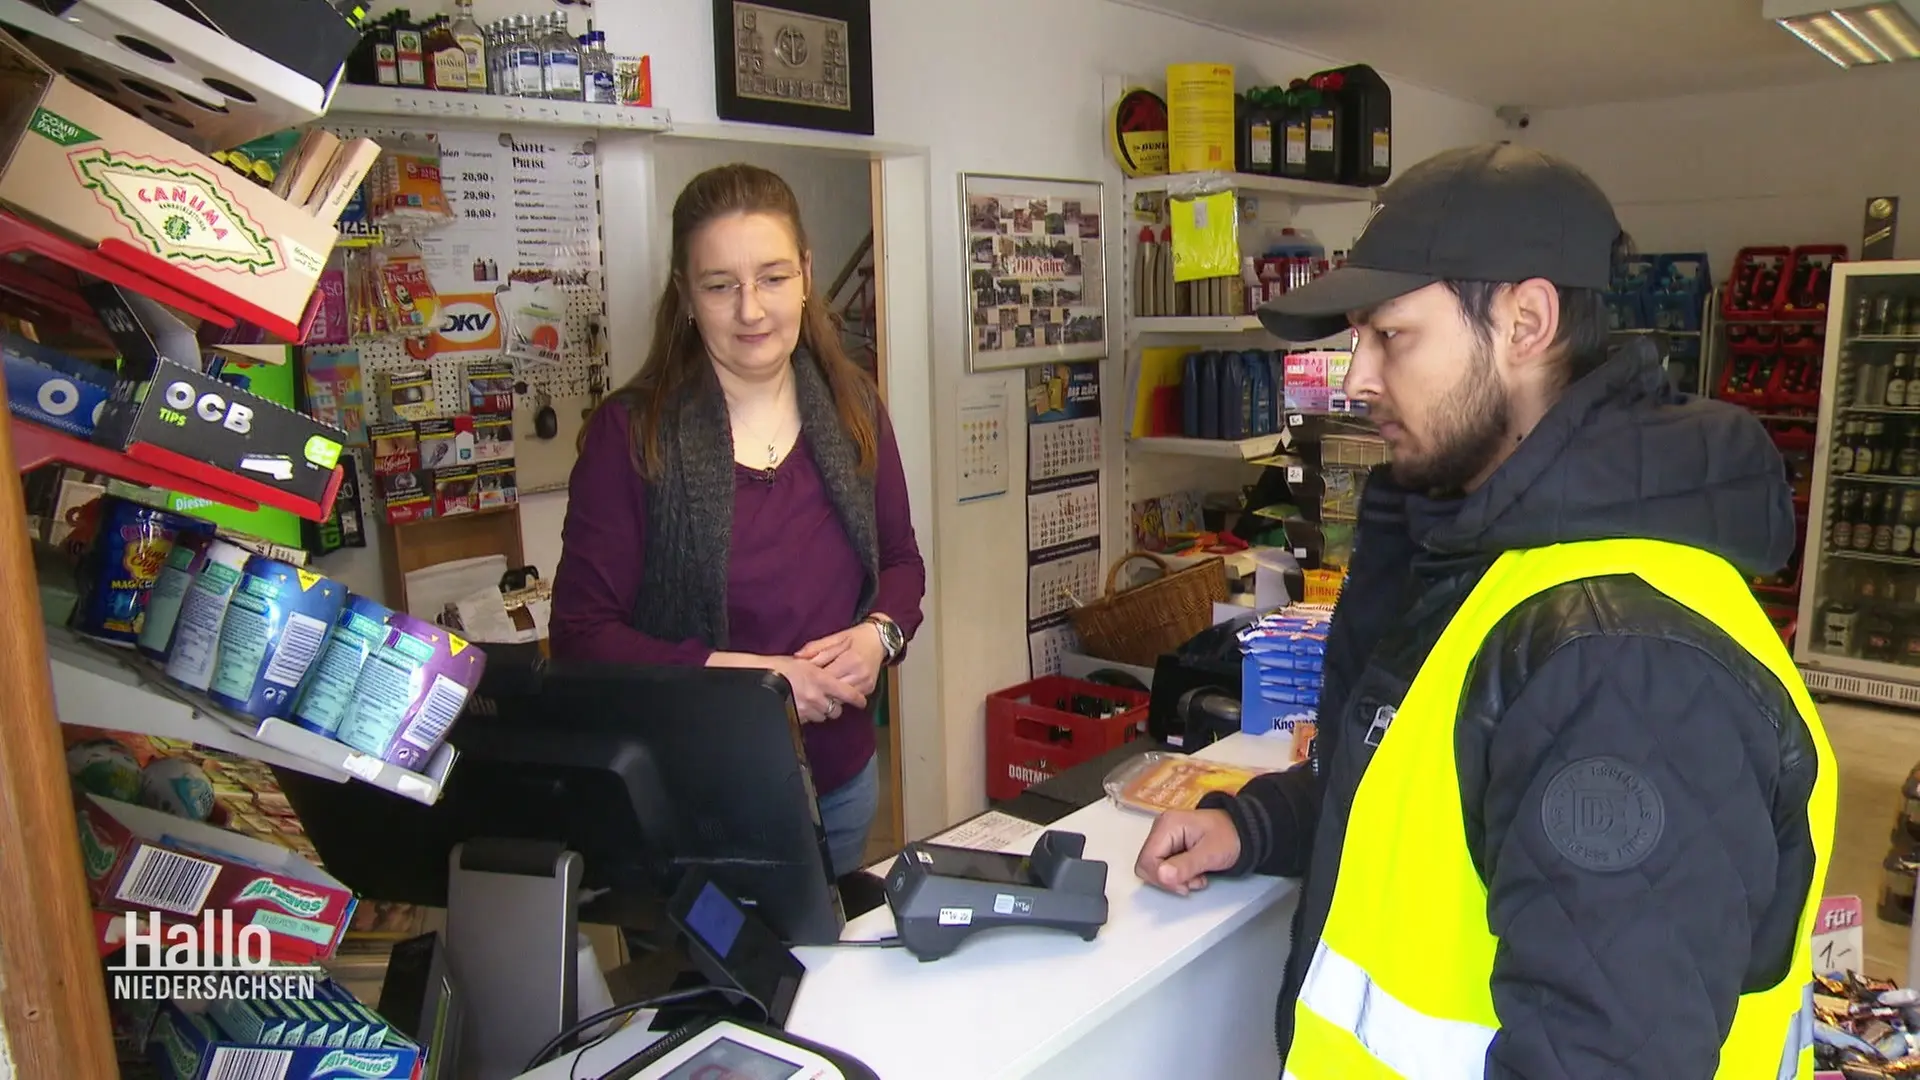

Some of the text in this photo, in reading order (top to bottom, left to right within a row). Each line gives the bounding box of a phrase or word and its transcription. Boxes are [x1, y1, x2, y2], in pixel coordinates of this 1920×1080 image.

[37, 120, 66, 142] PACK
[41, 112, 79, 138] COMBI
[159, 407, 187, 427] TIPS
[166, 381, 254, 434] OCB
[243, 880, 325, 912] Airwaves
[1824, 909, 1857, 928] für
[321, 1053, 393, 1075] Airwaves
